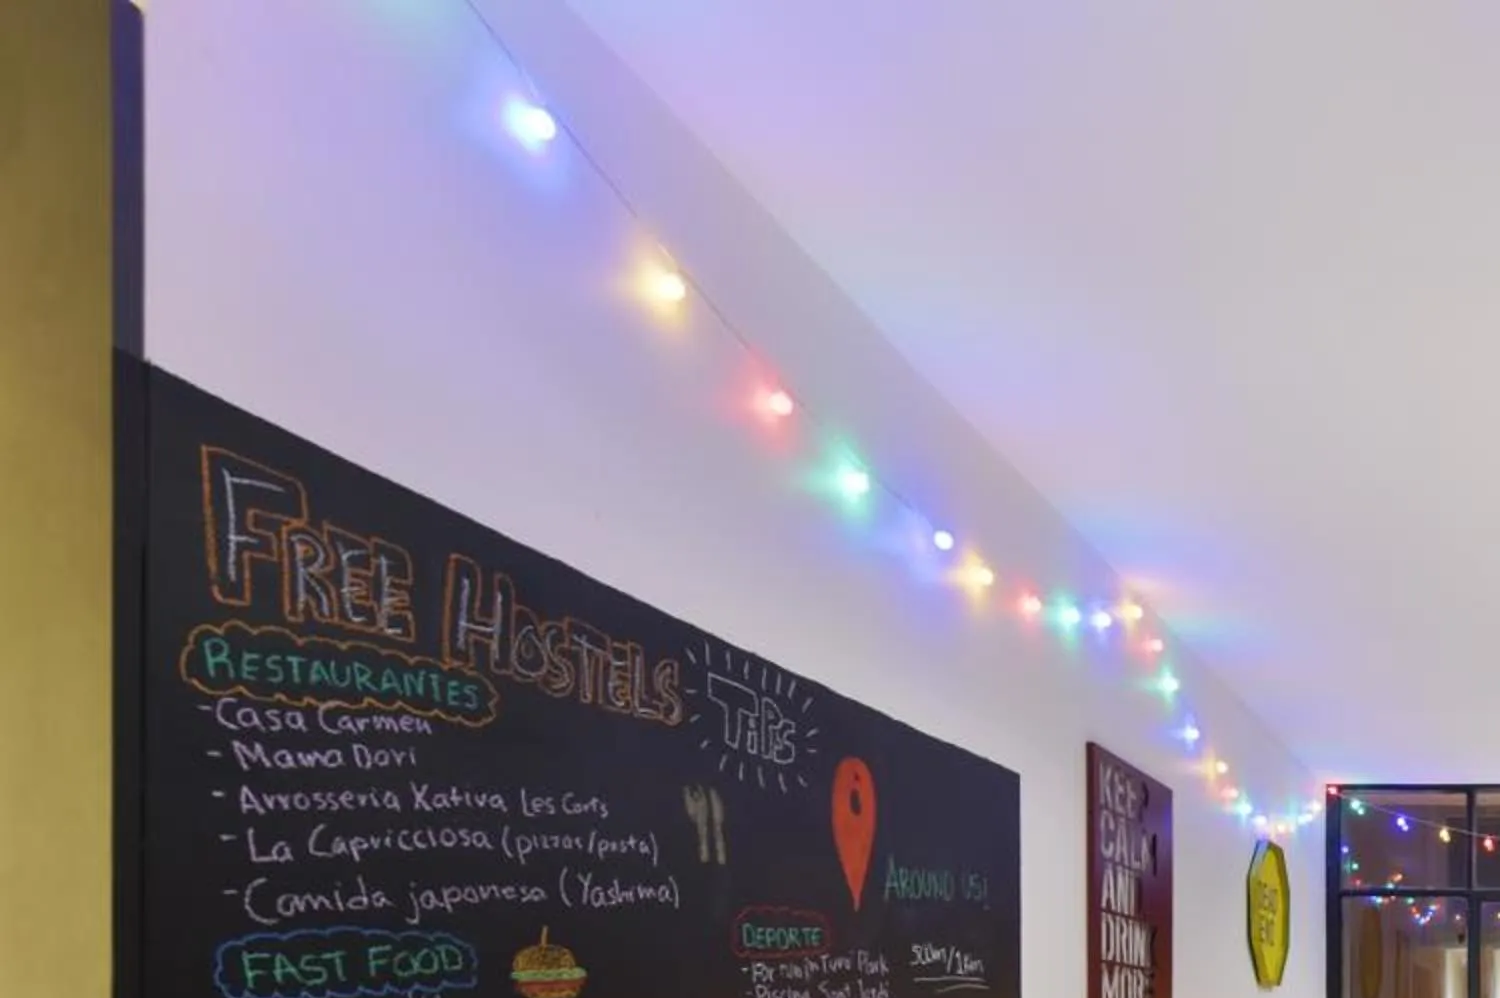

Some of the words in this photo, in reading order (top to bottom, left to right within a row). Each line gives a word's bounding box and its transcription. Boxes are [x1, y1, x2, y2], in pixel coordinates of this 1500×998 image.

[201, 443, 417, 642] FREE
[441, 552, 684, 728] HOSTELS
[202, 637, 479, 711] RESTAURANTES
[215, 697, 309, 732] Casa
[317, 700, 432, 735] Carmen
[231, 739, 345, 771] Mama
[520, 787, 556, 817] Les
[248, 826, 294, 862] La
[405, 880, 548, 925] japonesa
[740, 922, 822, 950] DEPORTE
[241, 949, 348, 988] FAST
[367, 944, 464, 979] FOOD
